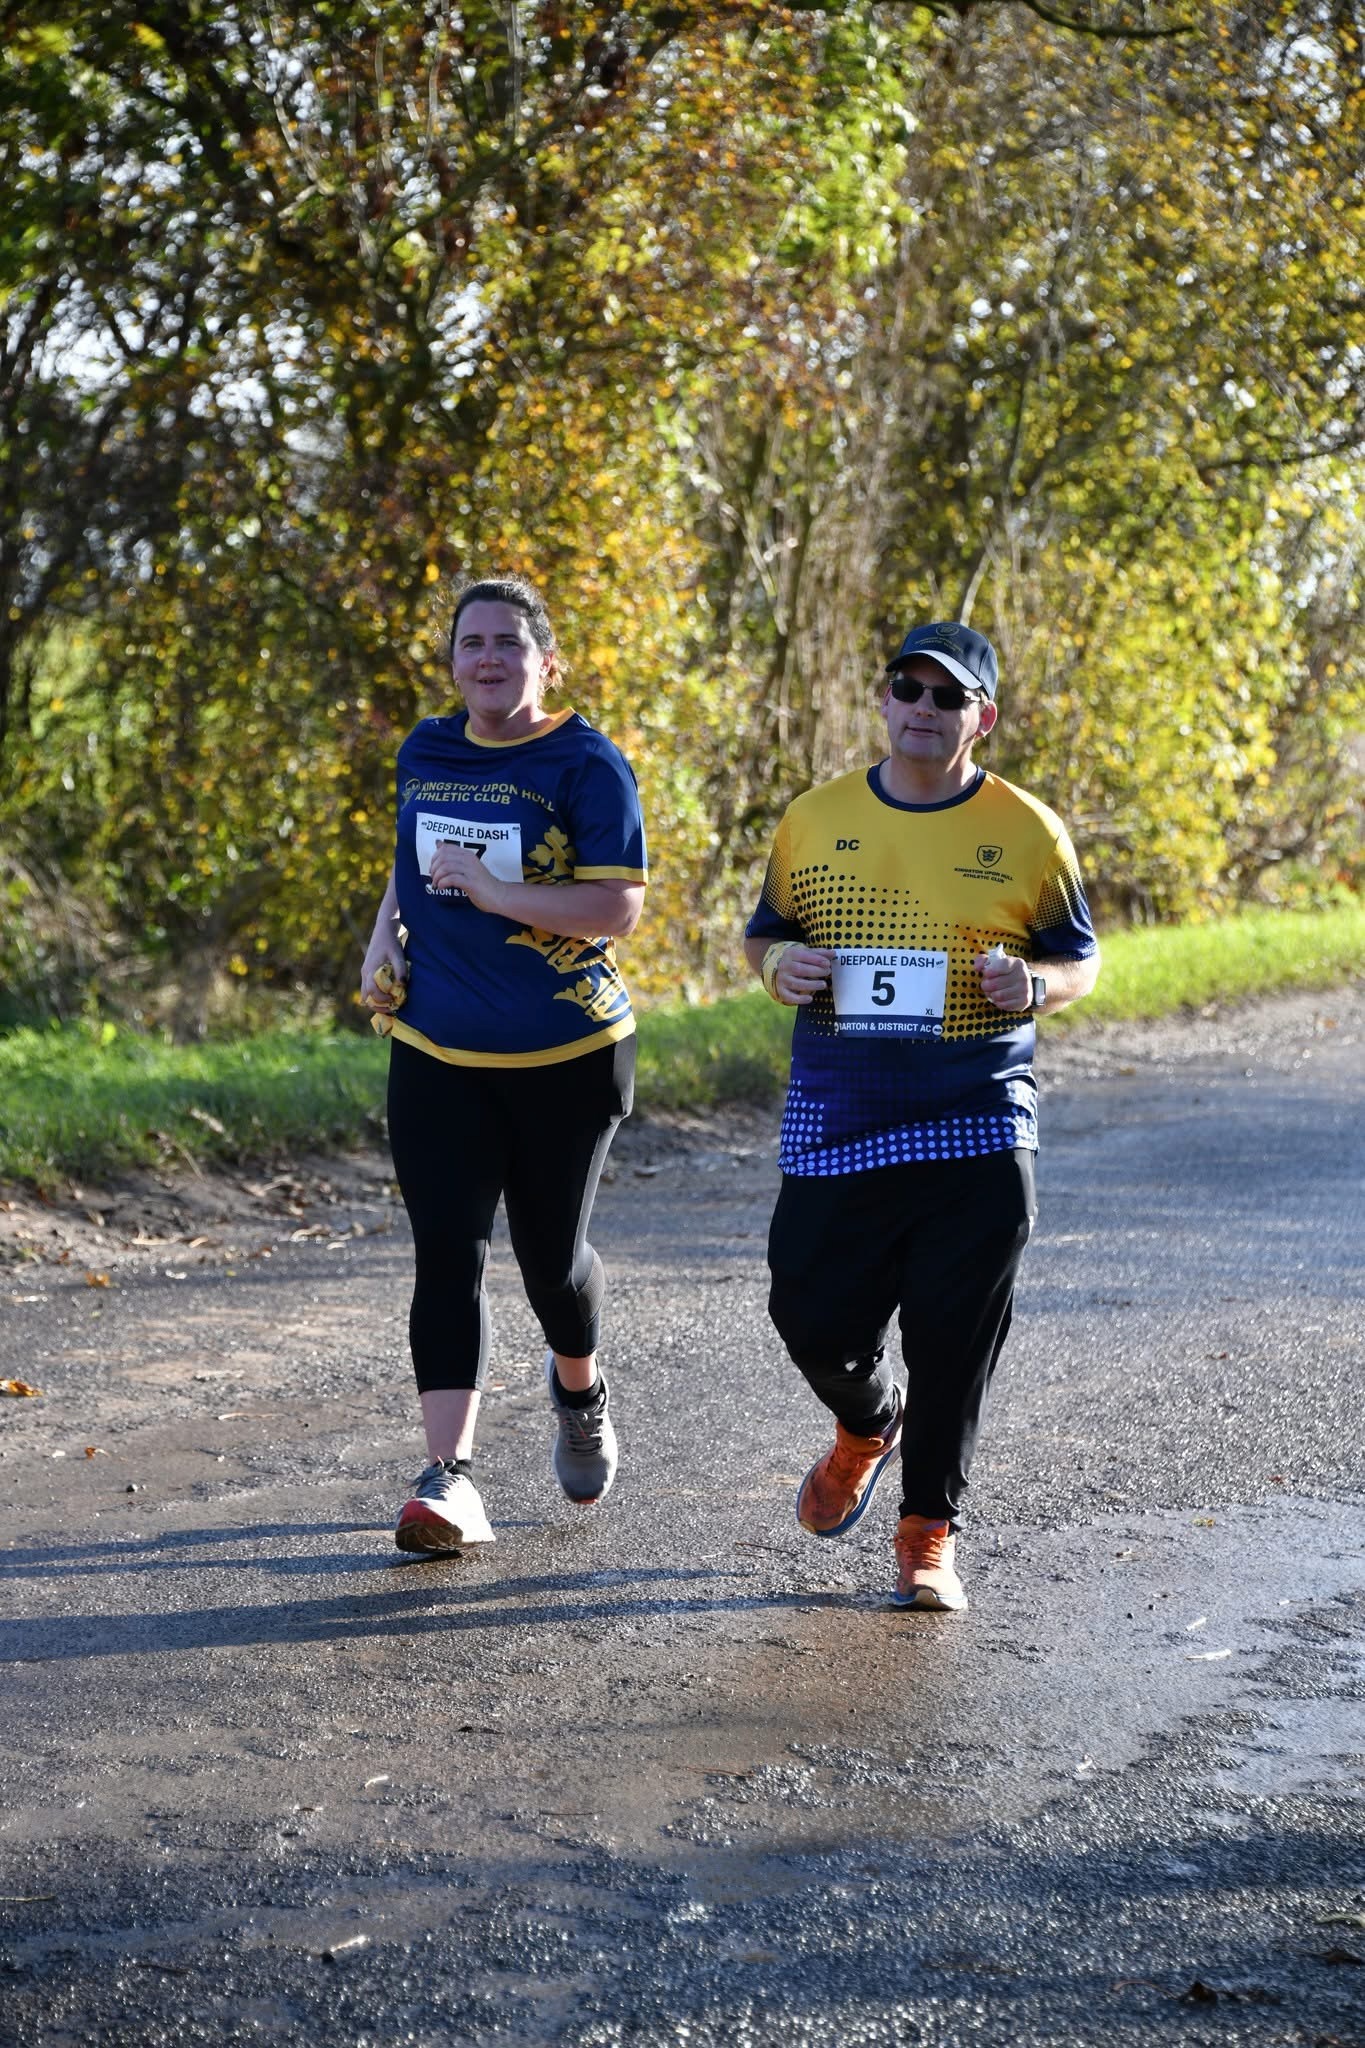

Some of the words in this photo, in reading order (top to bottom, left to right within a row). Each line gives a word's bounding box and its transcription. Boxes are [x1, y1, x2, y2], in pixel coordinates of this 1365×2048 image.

[415, 792, 471, 802] ATHLETIC
[474, 793, 511, 805] CLUB
[421, 781, 479, 792] KINGSTON
[482, 783, 518, 795] UPON
[521, 789, 555, 812] HULL
[426, 820, 475, 838] DEEPDALE
[476, 829, 509, 841] DASH
[443, 839, 487, 860] 7
[835, 839, 860, 851] DC
[840, 955, 898, 967] DEEPDALE
[900, 956, 935, 968] DASH
[871, 970, 896, 1007] 5
[925, 1008, 935, 1016] XL
[870, 1022, 877, 1031] &
[878, 1022, 919, 1032] DISTRICT
[920, 1024, 932, 1033] AC
